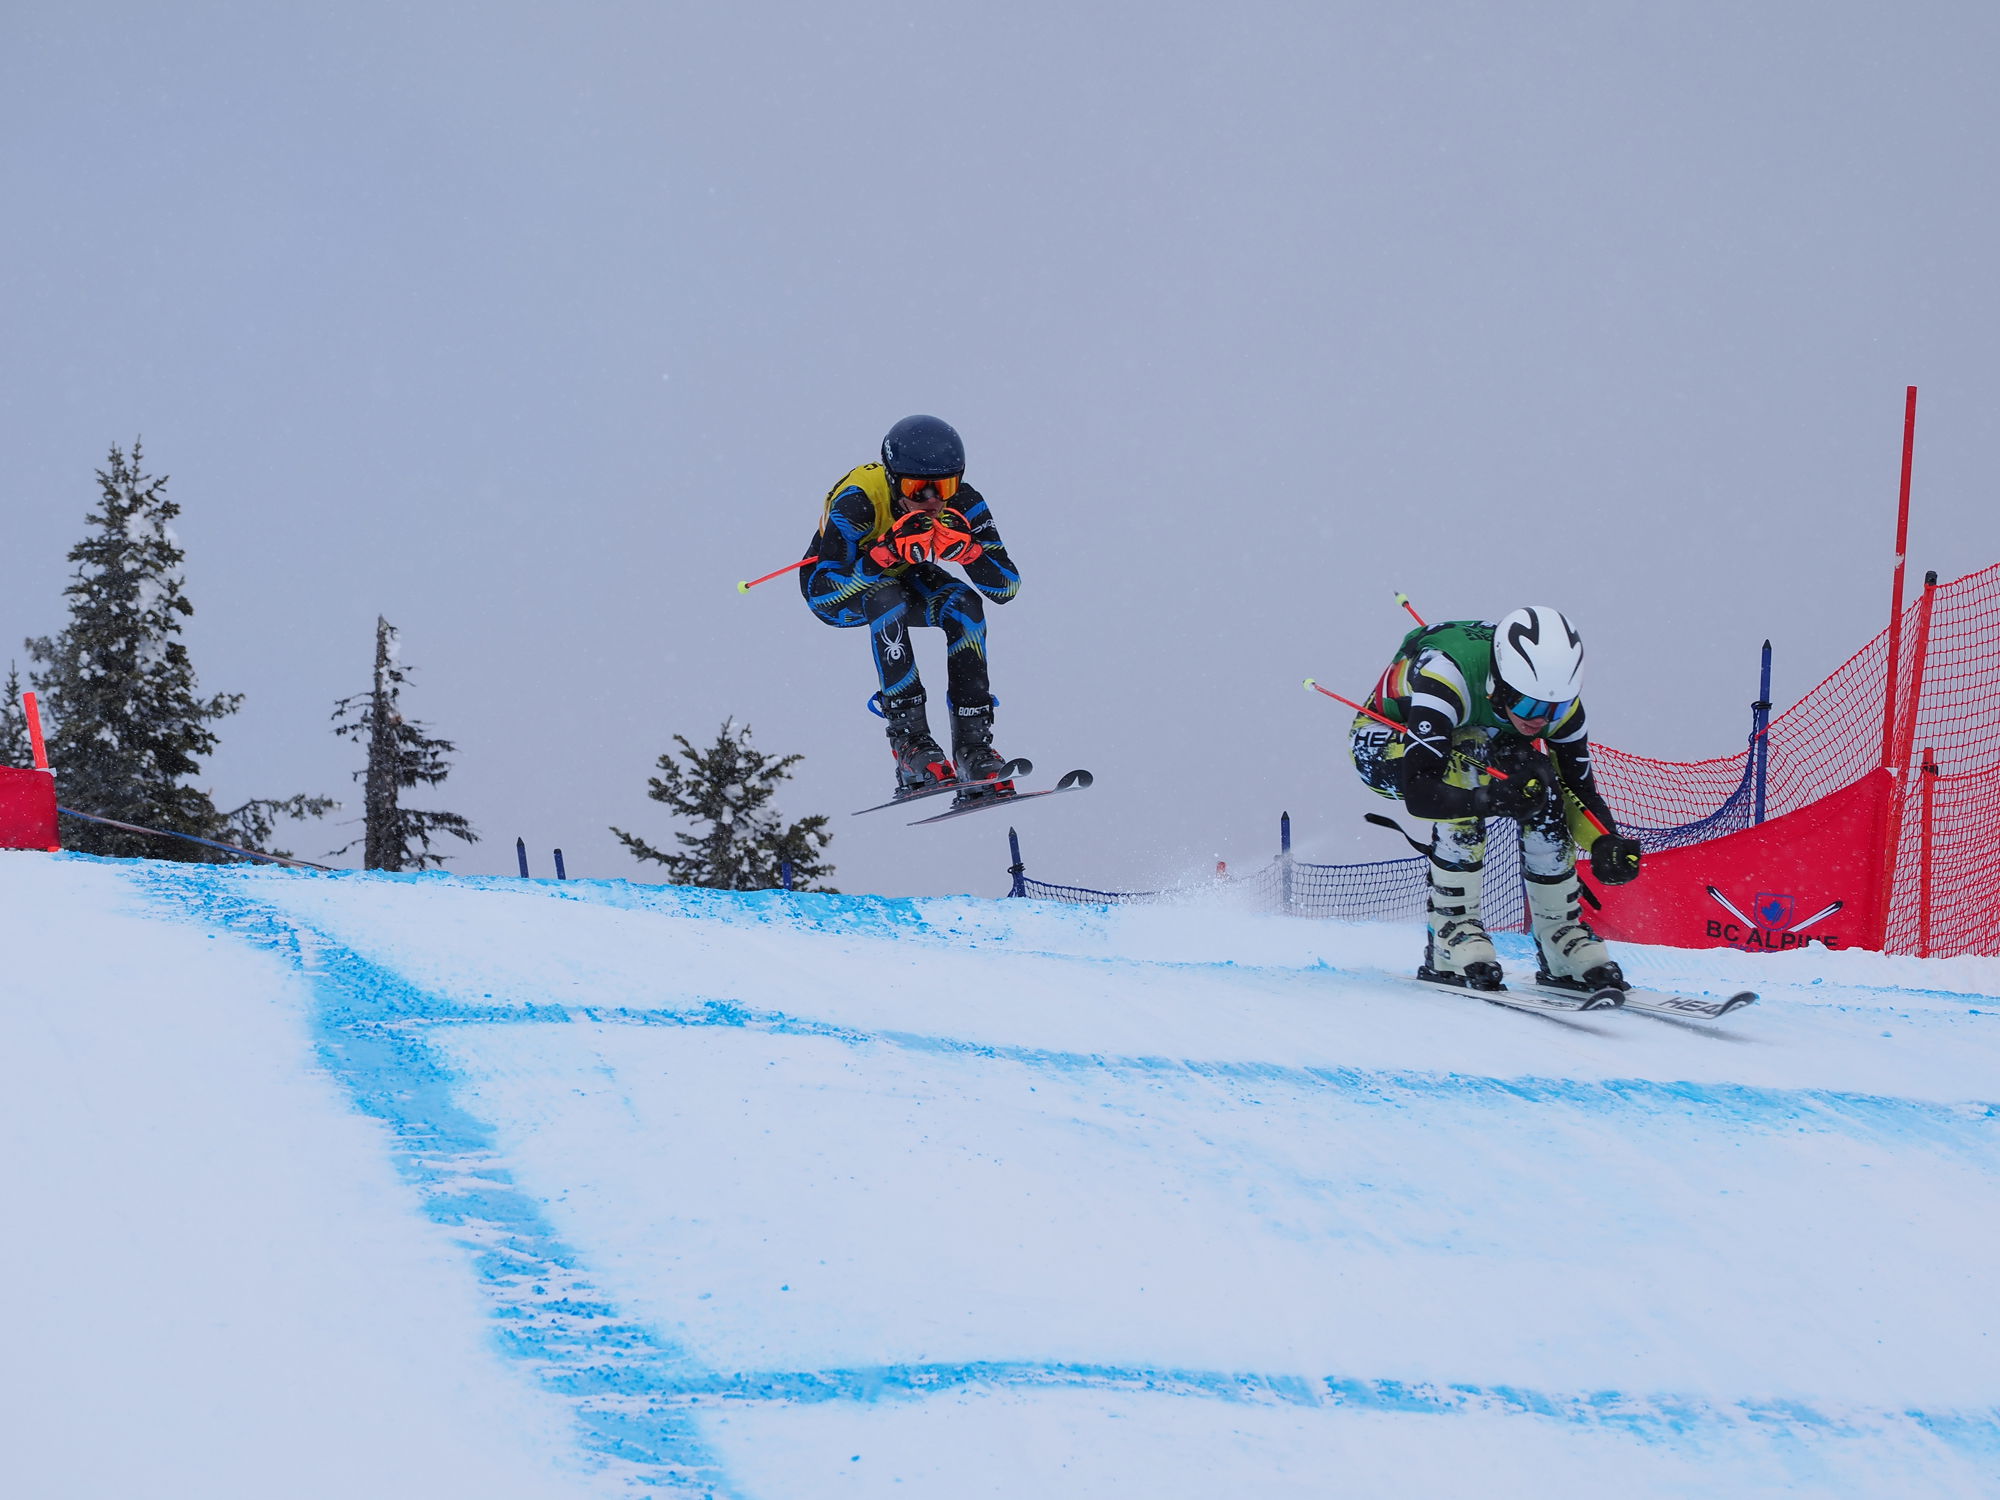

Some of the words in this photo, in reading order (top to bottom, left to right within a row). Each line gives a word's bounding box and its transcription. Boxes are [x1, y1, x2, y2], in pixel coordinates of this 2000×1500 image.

[1354, 731, 1403, 747] HEA
[1706, 920, 1740, 942] BC
[1658, 997, 1724, 1015] HEA
